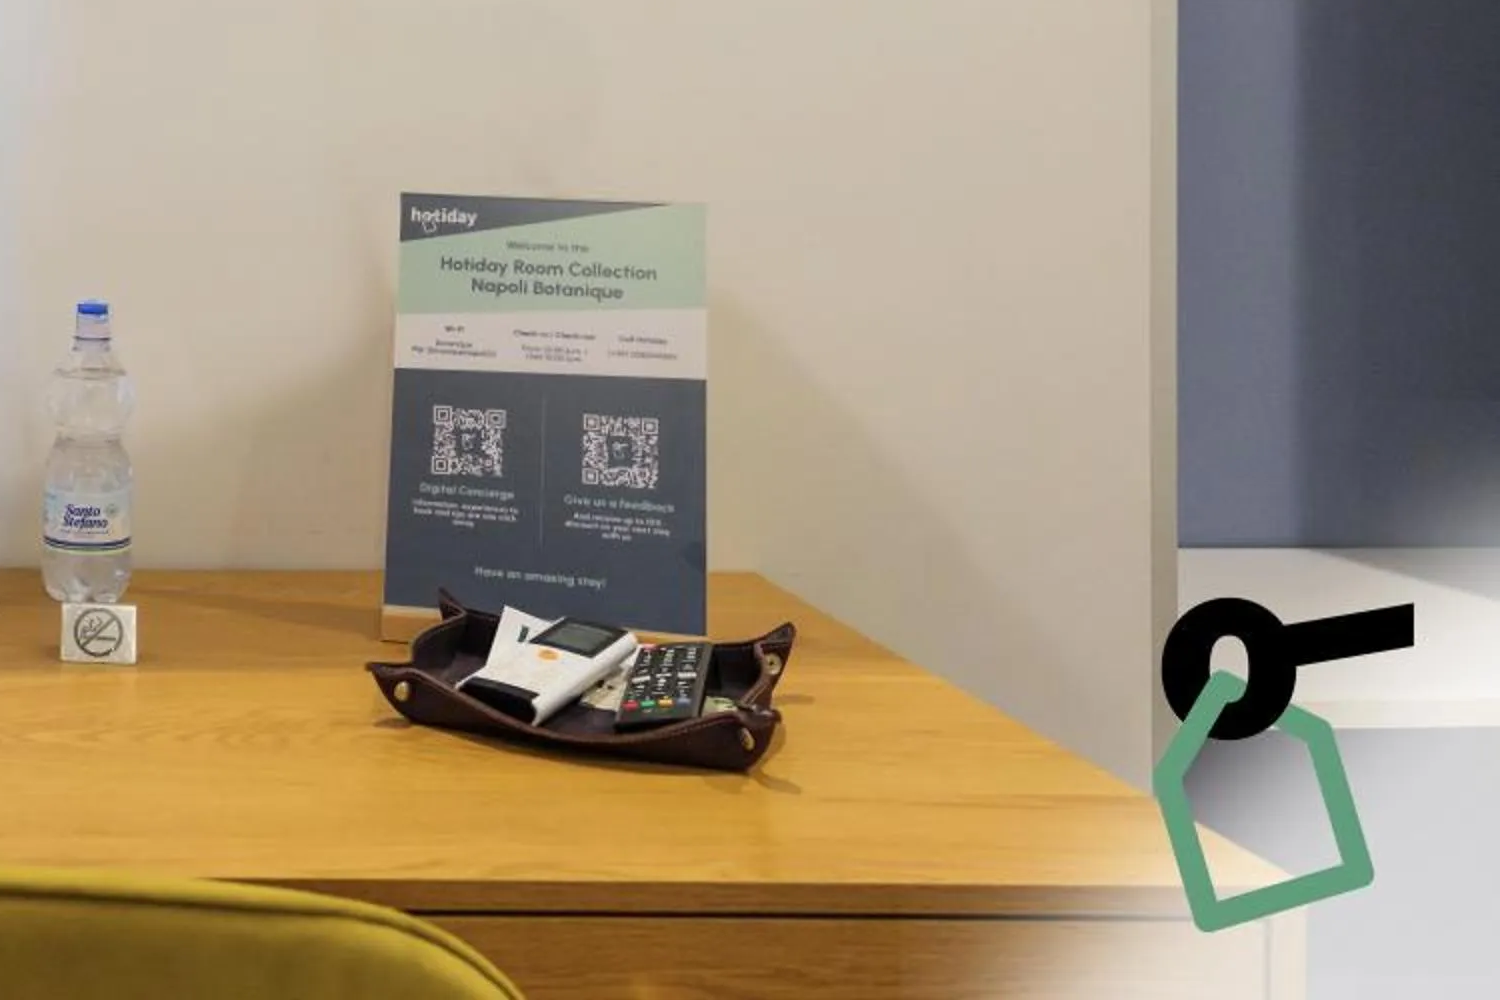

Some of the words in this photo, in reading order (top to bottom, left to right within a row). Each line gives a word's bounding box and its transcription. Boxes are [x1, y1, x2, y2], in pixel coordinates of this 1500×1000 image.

[411, 206, 478, 229] hotiday
[441, 256, 508, 278] Hotiday
[513, 259, 564, 277] Room
[569, 261, 658, 281] Collection
[471, 278, 528, 297] Napoli
[533, 281, 624, 303] Botanique
[419, 482, 457, 496] Digital
[460, 485, 515, 501] Concierge
[564, 494, 591, 505] Give
[66, 503, 101, 517] Santo
[63, 514, 109, 529] Stefano
[474, 565, 504, 578] Have
[524, 572, 575, 588] amazing
